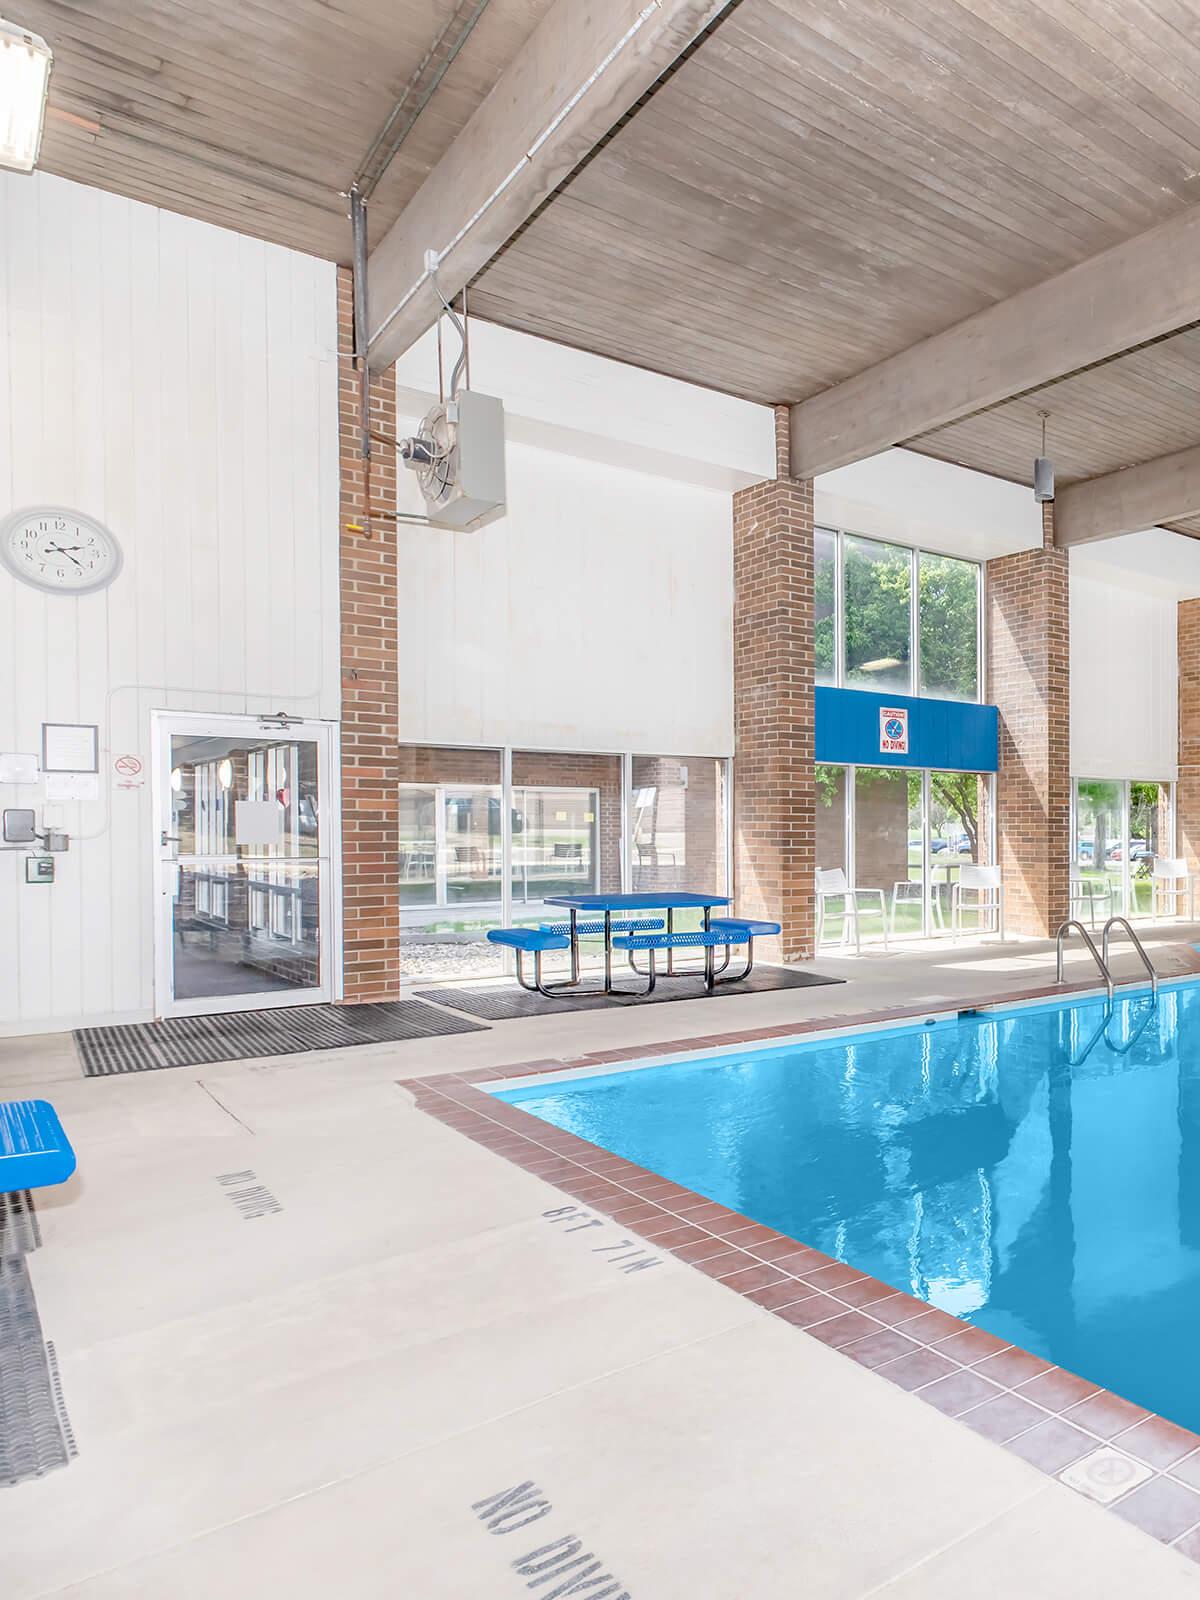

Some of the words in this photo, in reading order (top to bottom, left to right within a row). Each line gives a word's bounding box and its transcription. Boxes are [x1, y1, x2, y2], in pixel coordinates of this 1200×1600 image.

[39, 522, 47, 531] 11
[54, 520, 66, 531] 12
[25, 529, 38, 539] 10
[20, 540, 28, 549] 9
[87, 537, 95, 546] 2
[39, 563, 46, 573] 7
[56, 568, 65, 578] 6
[215, 1169, 257, 1186] NO
[223, 1185, 285, 1220] DIVING
[541, 1205, 604, 1233] 8FT
[591, 1239, 665, 1274] 7IN
[471, 1480, 553, 1535] NO
